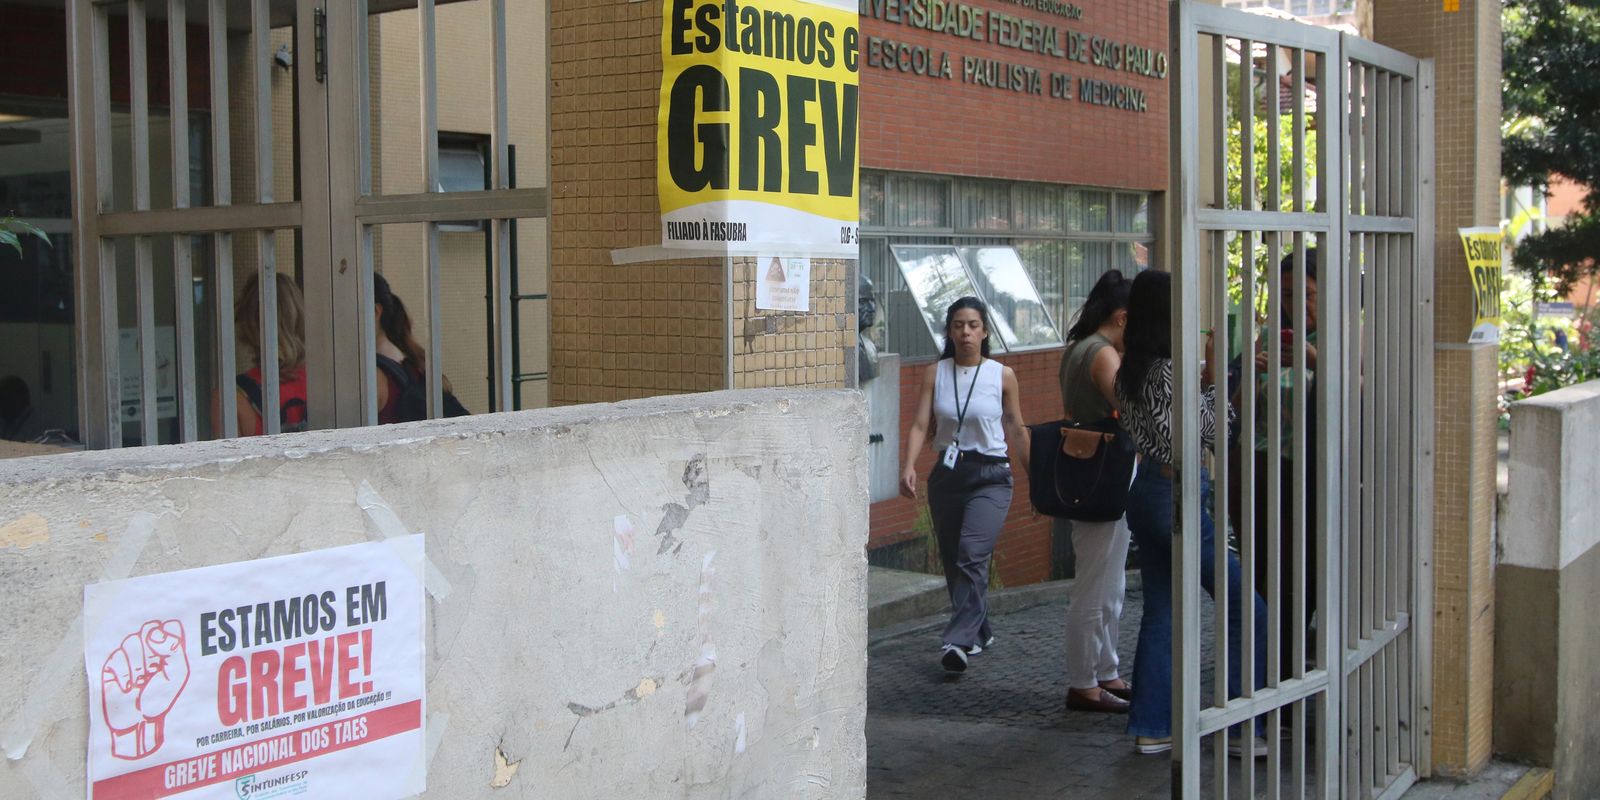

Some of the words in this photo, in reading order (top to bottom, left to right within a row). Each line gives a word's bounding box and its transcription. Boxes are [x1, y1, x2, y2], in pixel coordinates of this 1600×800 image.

[671, 0, 835, 68] Estamos
[987, 10, 1064, 57] FEDERAL
[1067, 30, 1089, 63] DE
[1124, 44, 1168, 79] PAULO
[868, 36, 952, 79] ESCOLA
[963, 56, 1042, 95] PAULISTA
[1051, 72, 1072, 99] DE
[1080, 77, 1147, 112] MEDICINA
[667, 221, 700, 241] FILIADO
[702, 218, 709, 241] À
[710, 221, 747, 242] FASUBRA
[200, 590, 336, 656] ESTAMOS
[346, 580, 387, 627] EM
[217, 628, 373, 727] GREVE!
[164, 755, 217, 790] GREVE
[221, 737, 297, 775] NACIONAL
[301, 726, 331, 754] DOS
[334, 717, 369, 746] TAES
[196, 736, 210, 748] POR
[246, 724, 259, 736] POR
[293, 711, 306, 724] POR
[307, 701, 346, 720] VALORIZAÇÃO
[347, 701, 356, 711] DA
[356, 691, 384, 706] EDUCAÇÃO
